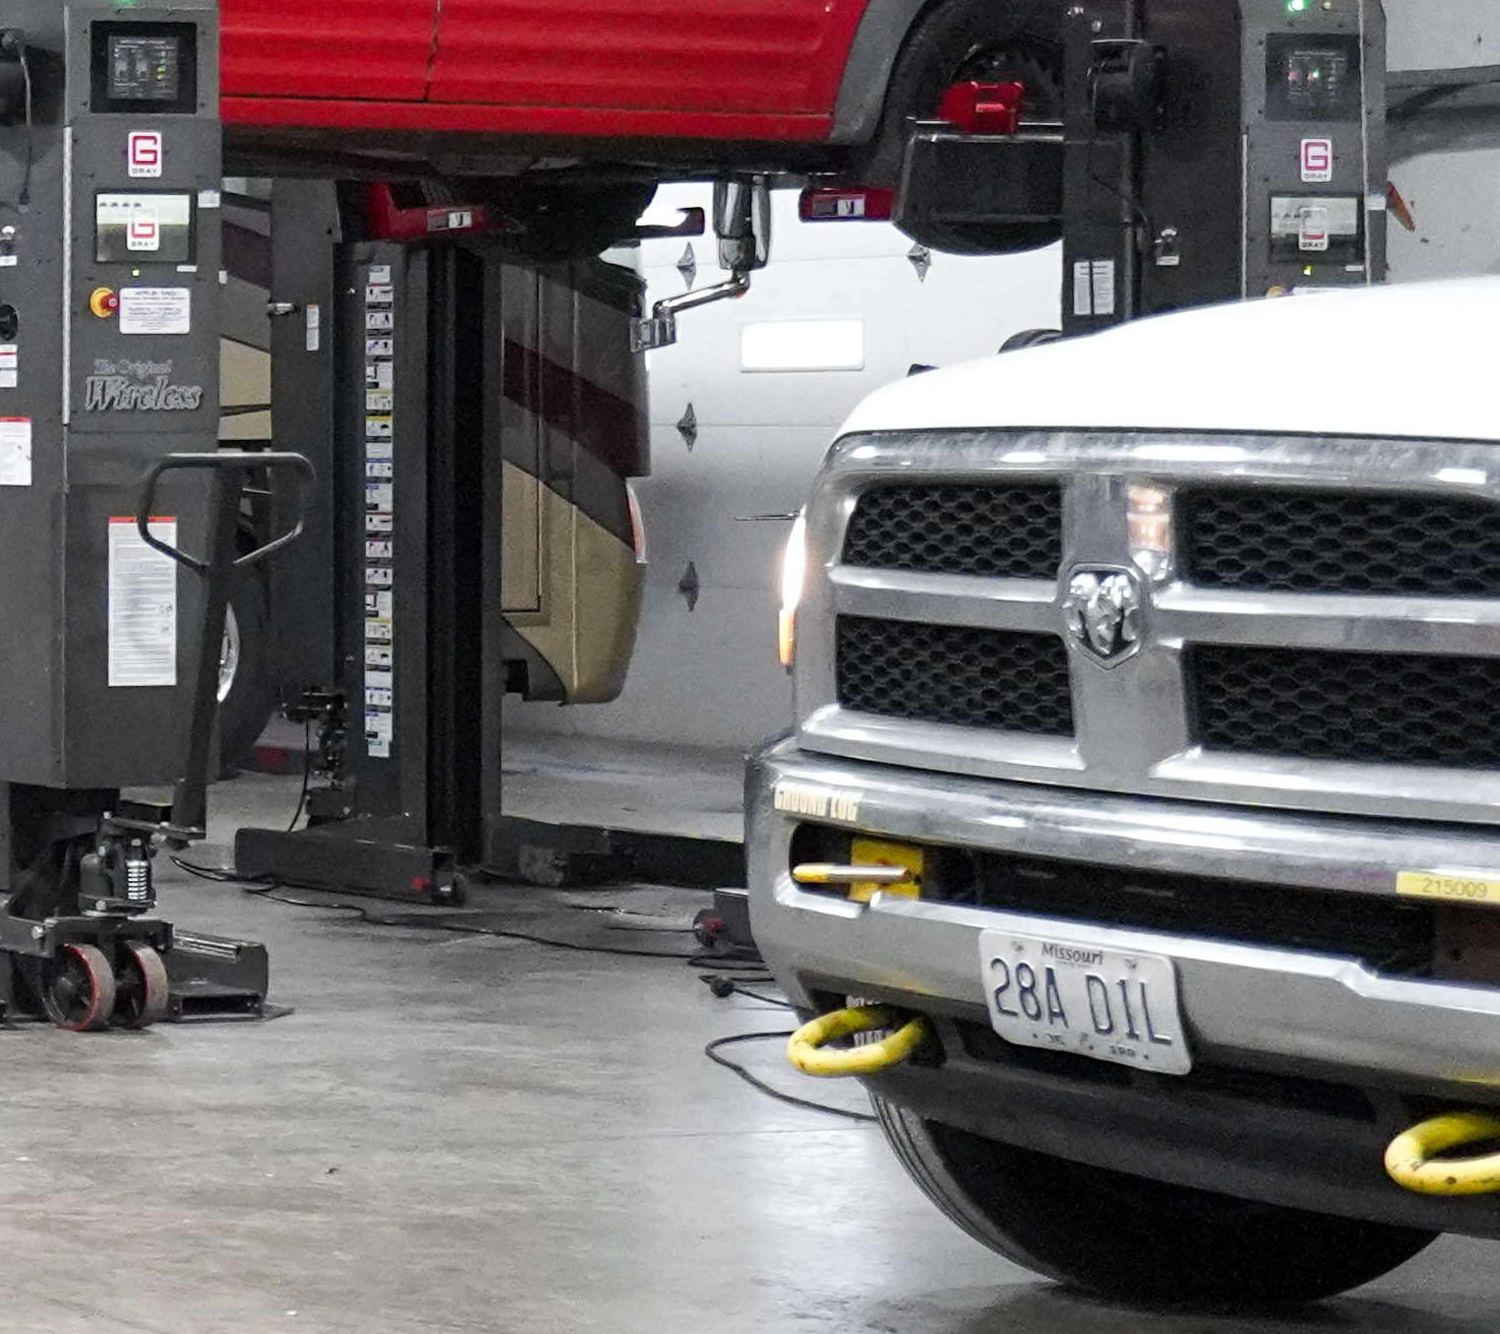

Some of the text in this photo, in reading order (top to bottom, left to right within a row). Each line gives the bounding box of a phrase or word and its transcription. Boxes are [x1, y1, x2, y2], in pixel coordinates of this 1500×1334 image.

[85, 375, 203, 411] Wireless
[1421, 876, 1488, 898] 215009
[1041, 942, 1104, 965] Missouri
[990, 955, 1070, 1029] 28A
